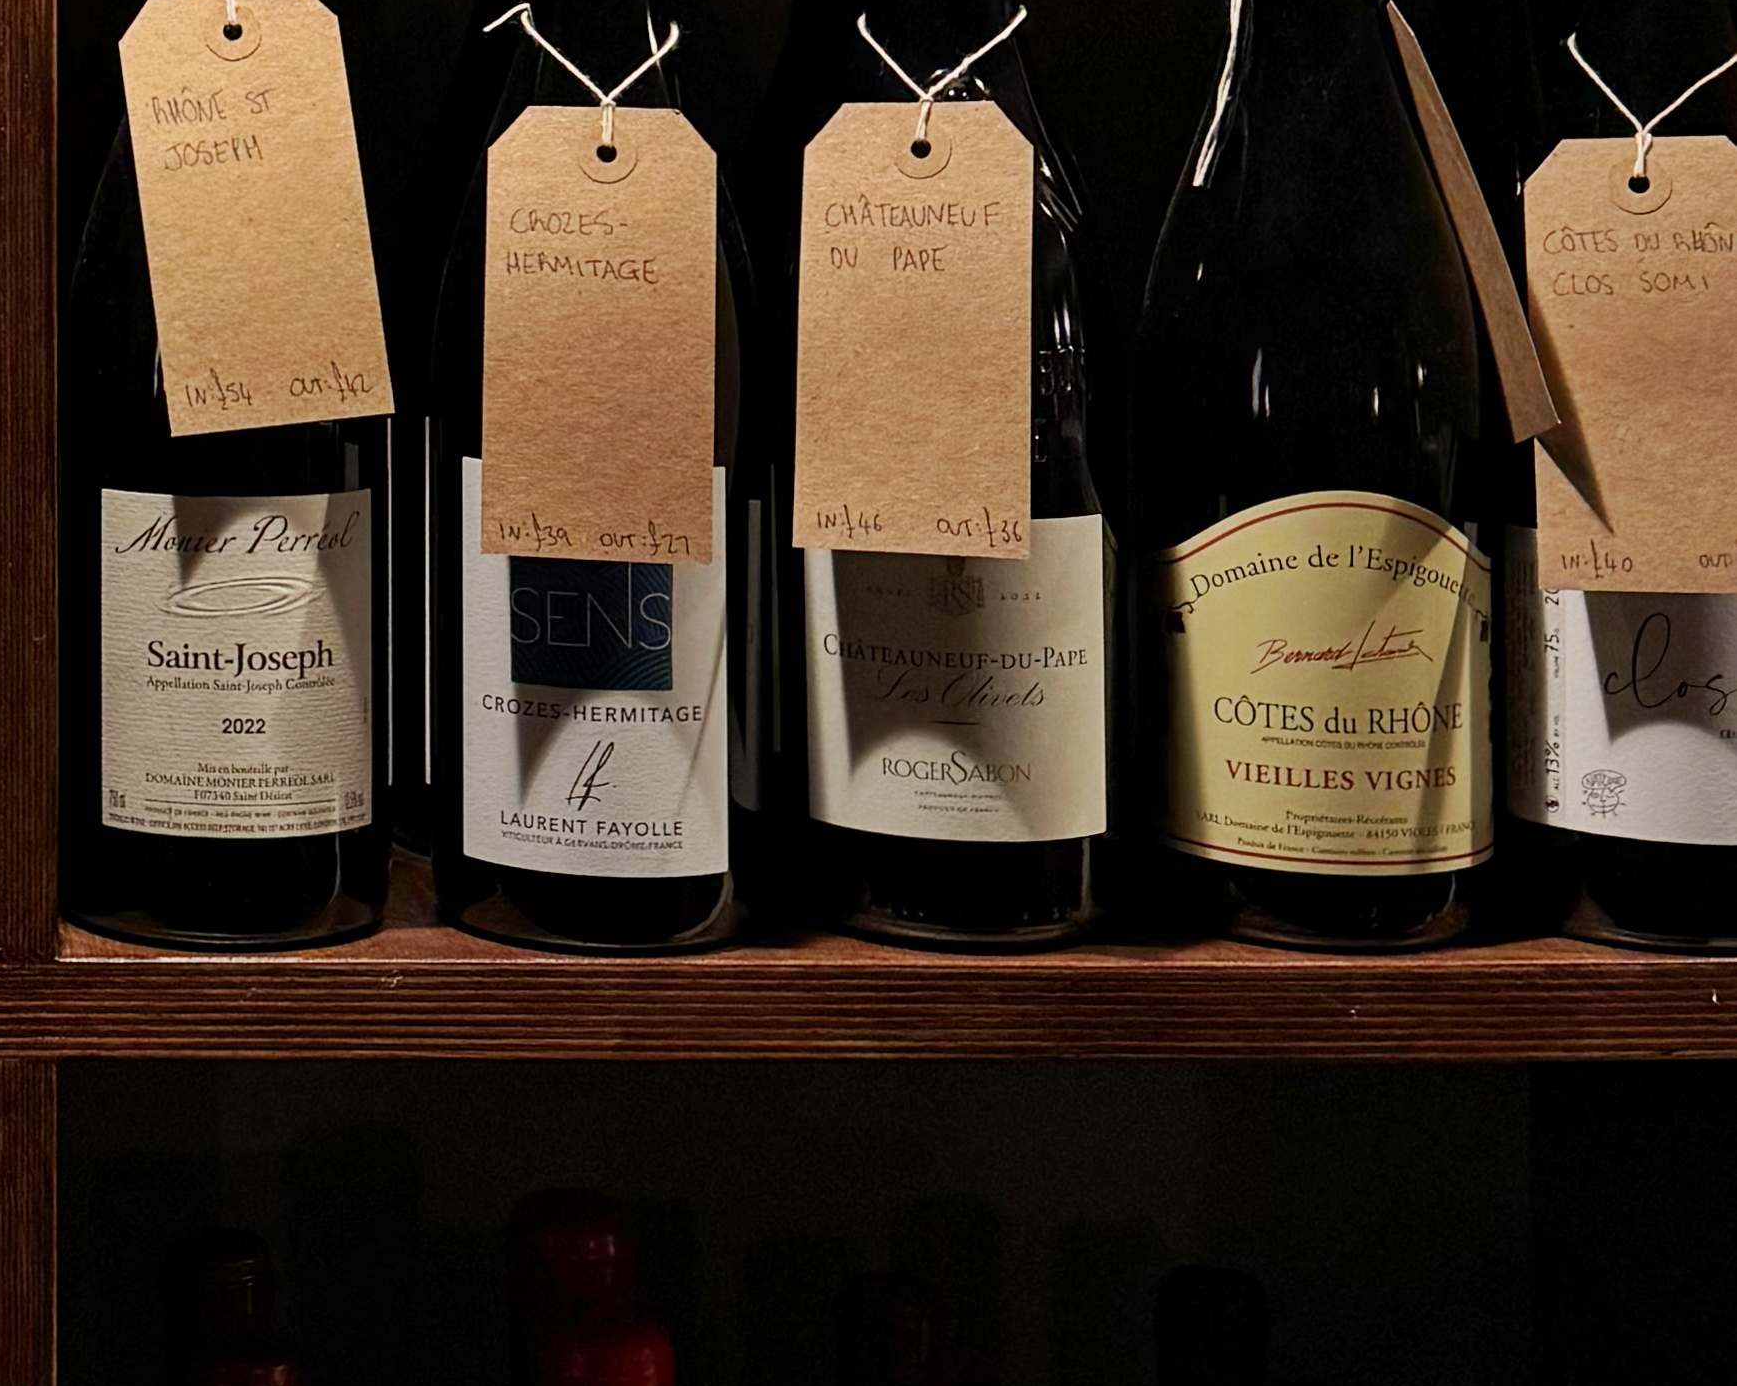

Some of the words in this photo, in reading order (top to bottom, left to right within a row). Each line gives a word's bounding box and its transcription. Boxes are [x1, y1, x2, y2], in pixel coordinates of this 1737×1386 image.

[151, 87, 225, 125] RHÔNE
[245, 88, 276, 114] ST
[164, 134, 263, 172] JOSEPH
[1543, 226, 1617, 255] CÔTES
[1634, 231, 1660, 251] DU
[506, 251, 660, 285] HERMITAGE
[830, 246, 858, 270] DU
[893, 244, 947, 273] PAPE
[1553, 271, 1614, 297] CLOS
[116, 515, 237, 555] Monier
[1190, 551, 1299, 599] Domaine
[1307, 544, 1339, 569] de
[510, 562, 673, 651] SENS
[147, 640, 334, 680] Saint-Joseph
[823, 633, 1088, 670] CHÂTEAUNEUF-DU-PAPE
[146, 676, 210, 693] Appellation
[213, 677, 283, 695] Saint-Joseph
[482, 693, 703, 723] CROZES-HERMITAGE
[1214, 694, 1315, 733] CÔTES
[1325, 703, 1357, 734] du
[1368, 696, 1463, 735] RHÔNE
[221, 718, 267, 735] 2022
[1224, 758, 1355, 792] VIEILLES
[1364, 765, 1457, 792] VIGNES
[500, 810, 588, 836] LAURENT
[596, 820, 684, 837] FAYOLLE
